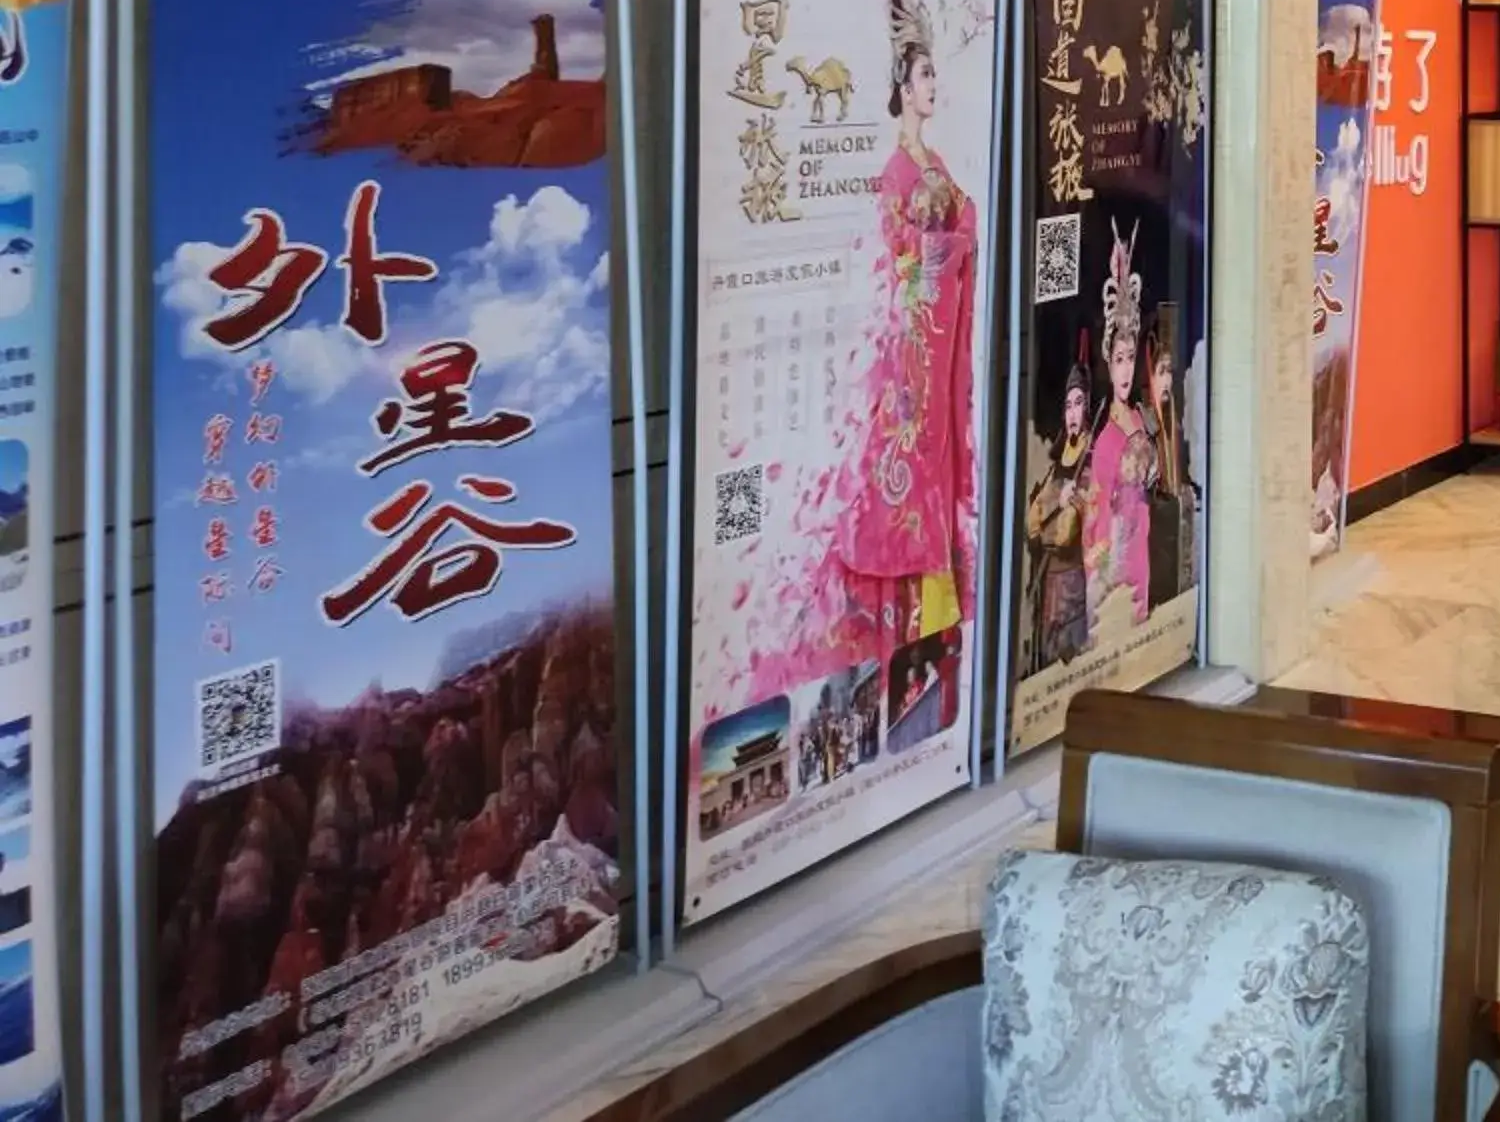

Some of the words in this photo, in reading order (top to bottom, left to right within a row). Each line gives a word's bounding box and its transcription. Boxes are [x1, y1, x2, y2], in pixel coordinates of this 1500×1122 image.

[799, 135, 878, 155] MEMORY
[799, 159, 824, 177] OF
[799, 176, 882, 199] ZHANGYE
[201, 180, 577, 628] 外星谷
